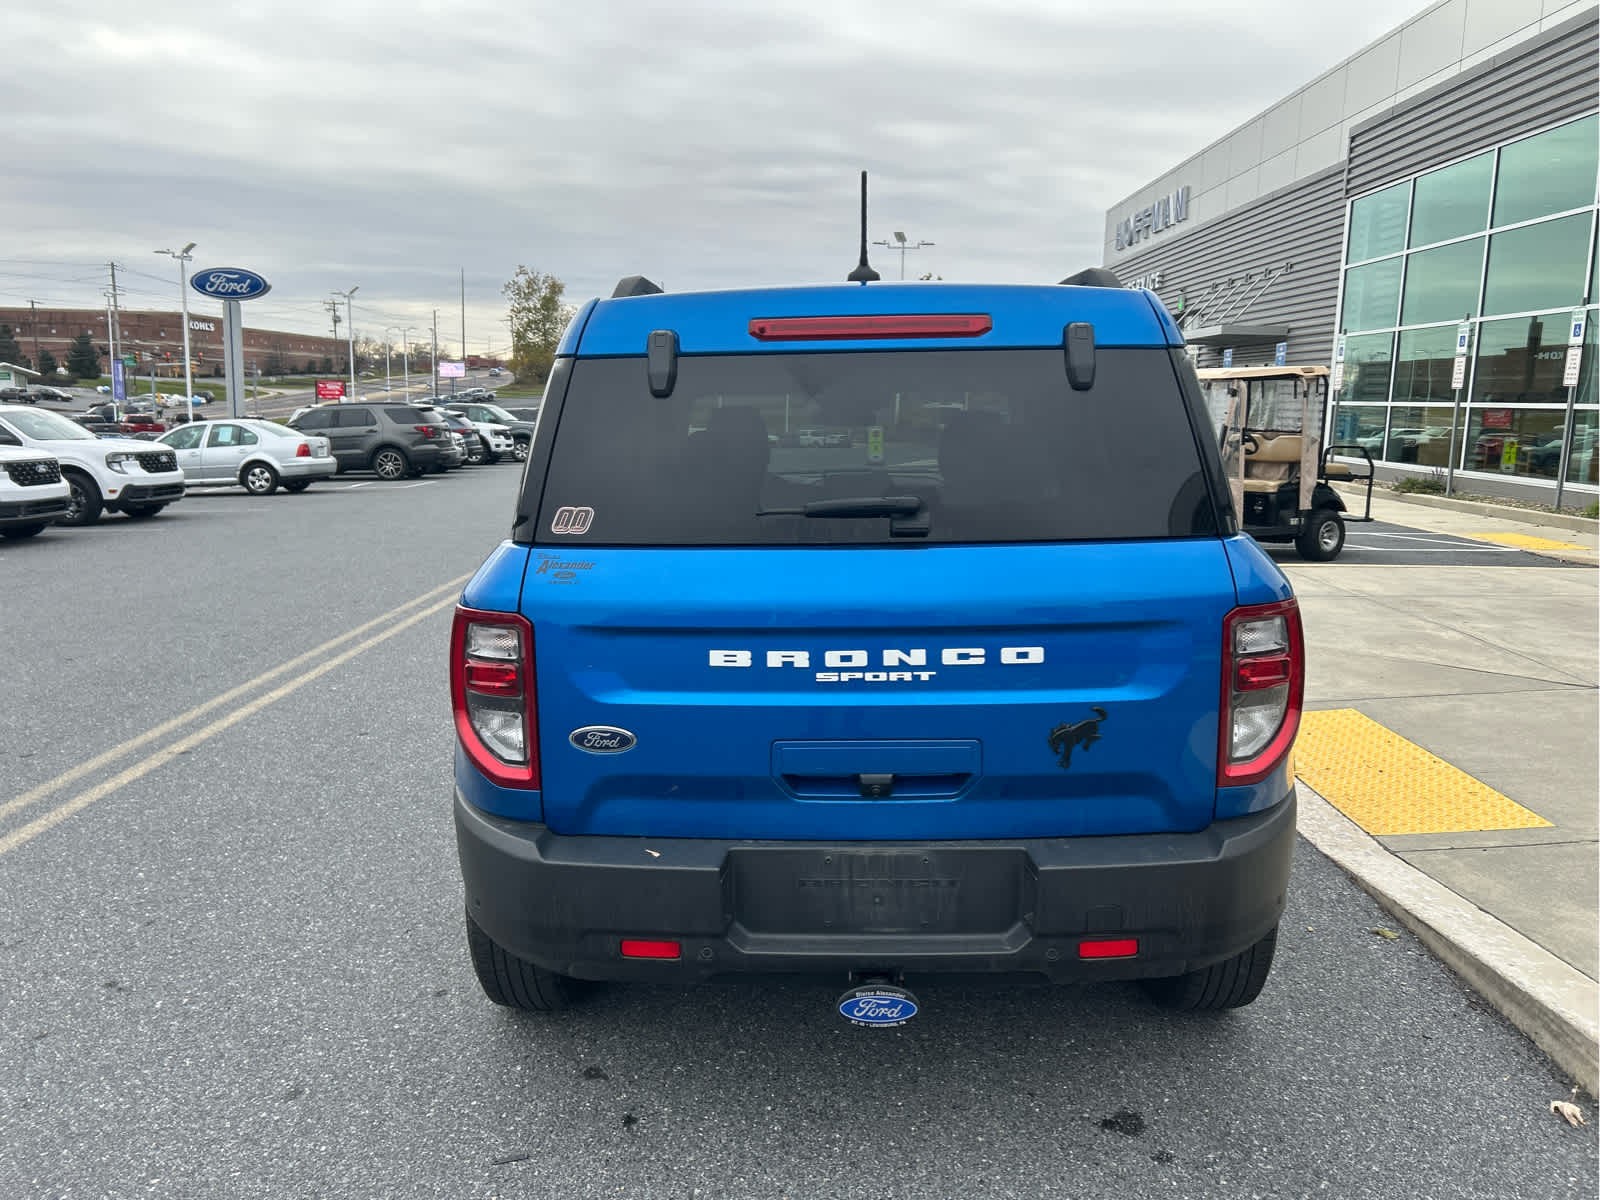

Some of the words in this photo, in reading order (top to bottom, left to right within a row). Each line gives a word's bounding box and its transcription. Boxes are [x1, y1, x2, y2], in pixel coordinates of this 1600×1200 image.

[1115, 185, 1190, 251] HOFFMAN
[205, 272, 251, 295] Ford
[189, 320, 215, 332] KOHL'S
[709, 647, 1045, 668] BRONCO
[815, 671, 937, 682] SPORT
[584, 732, 620, 748] Ford
[854, 999, 902, 1017] Ford
